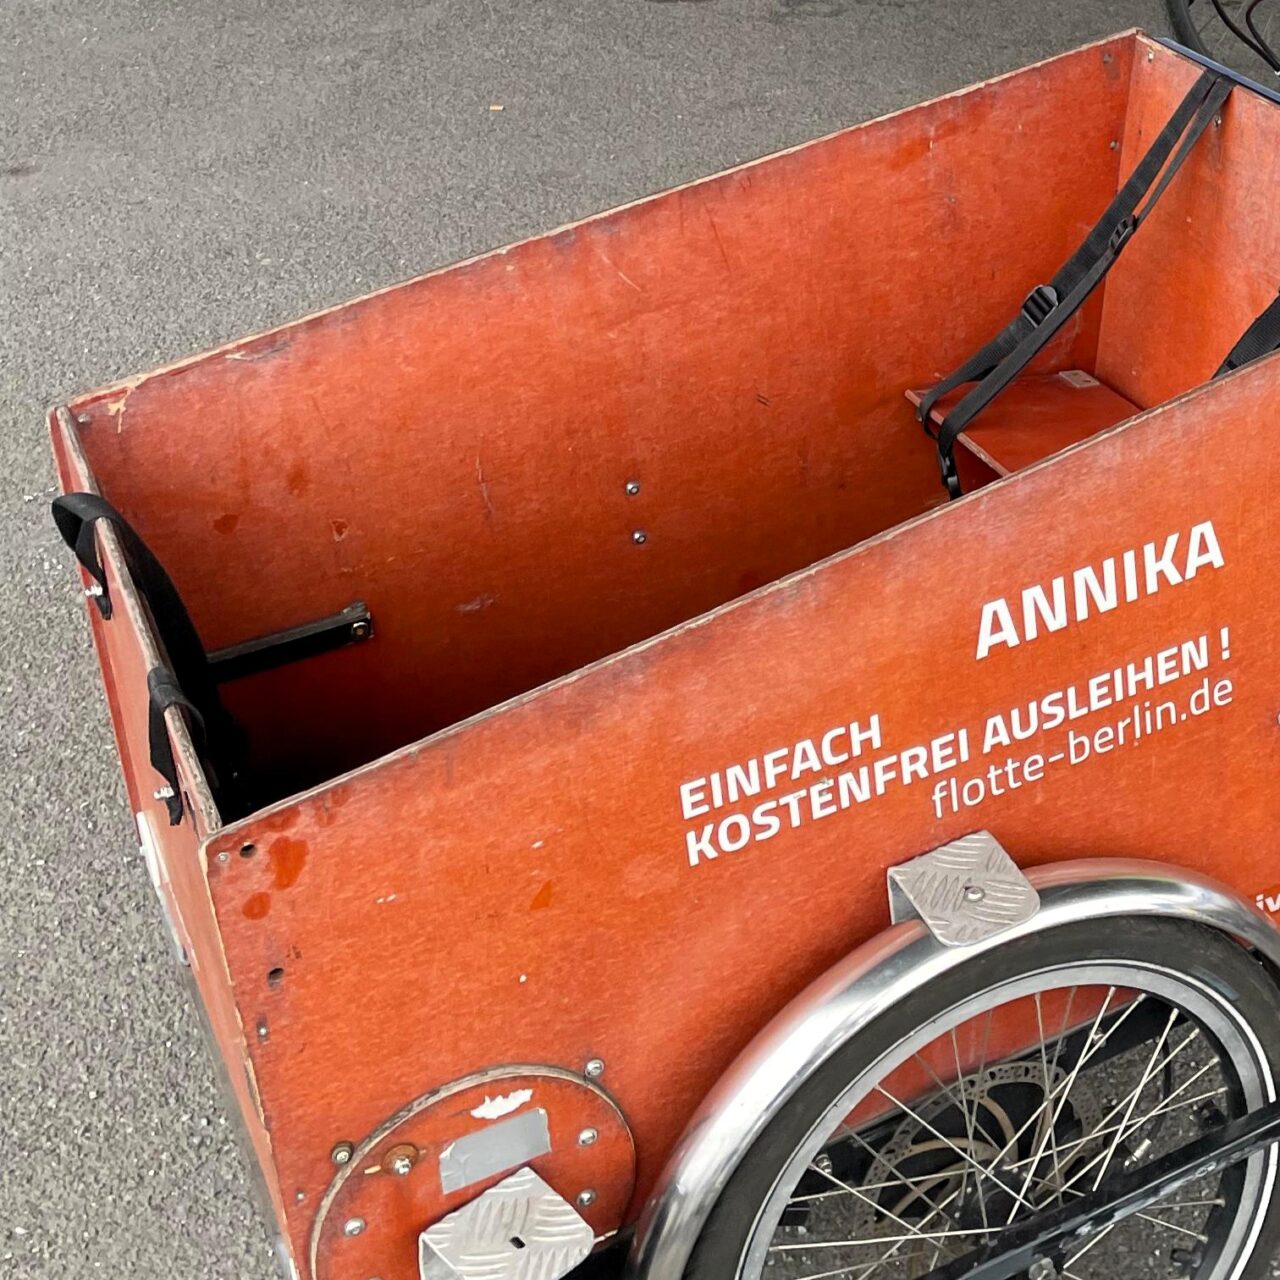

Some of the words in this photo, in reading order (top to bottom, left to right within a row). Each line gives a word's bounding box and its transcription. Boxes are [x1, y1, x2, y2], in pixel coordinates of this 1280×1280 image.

[975, 520, 1225, 660] ANNIKA
[679, 713, 883, 821] EINFACH
[685, 728, 970, 867] KOSTENFREI
[982, 635, 1209, 755] AUSLEIHEN
[931, 675, 1235, 820] flotte-berlin.de
